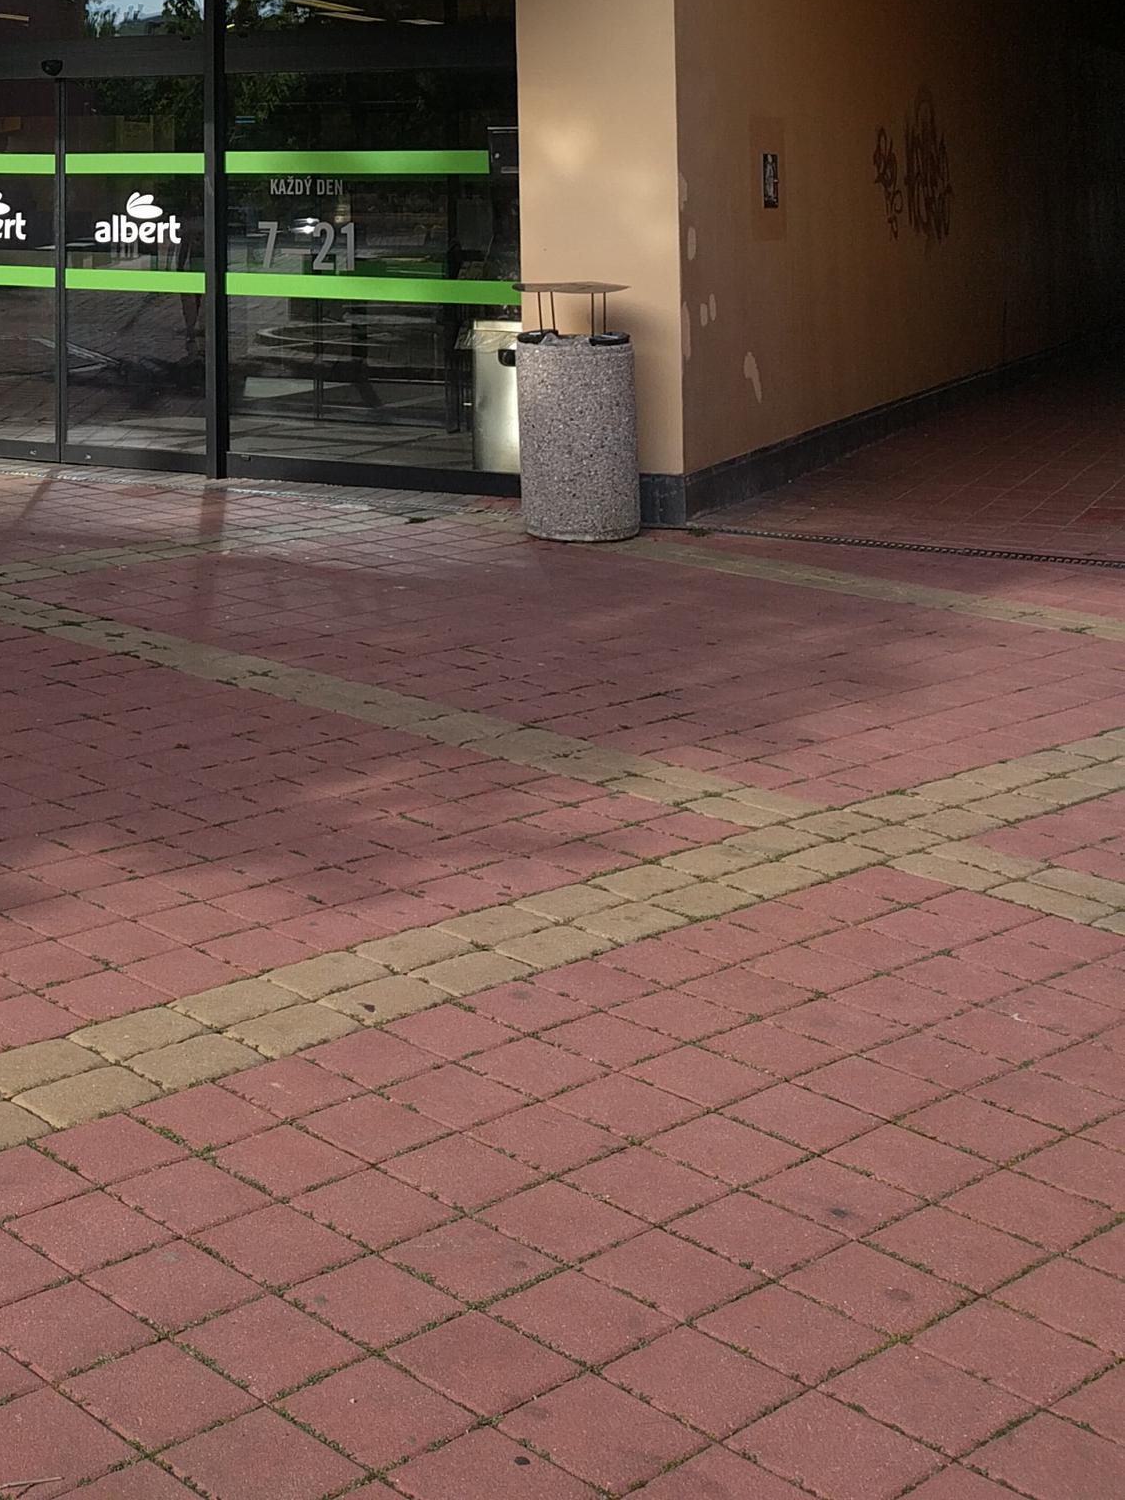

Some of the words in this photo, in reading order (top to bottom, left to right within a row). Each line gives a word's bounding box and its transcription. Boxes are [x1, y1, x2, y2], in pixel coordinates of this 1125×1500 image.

[270, 175, 313, 195] KAŽDÝ
[317, 179, 343, 195] DEN
[94, 214, 182, 244] albert
